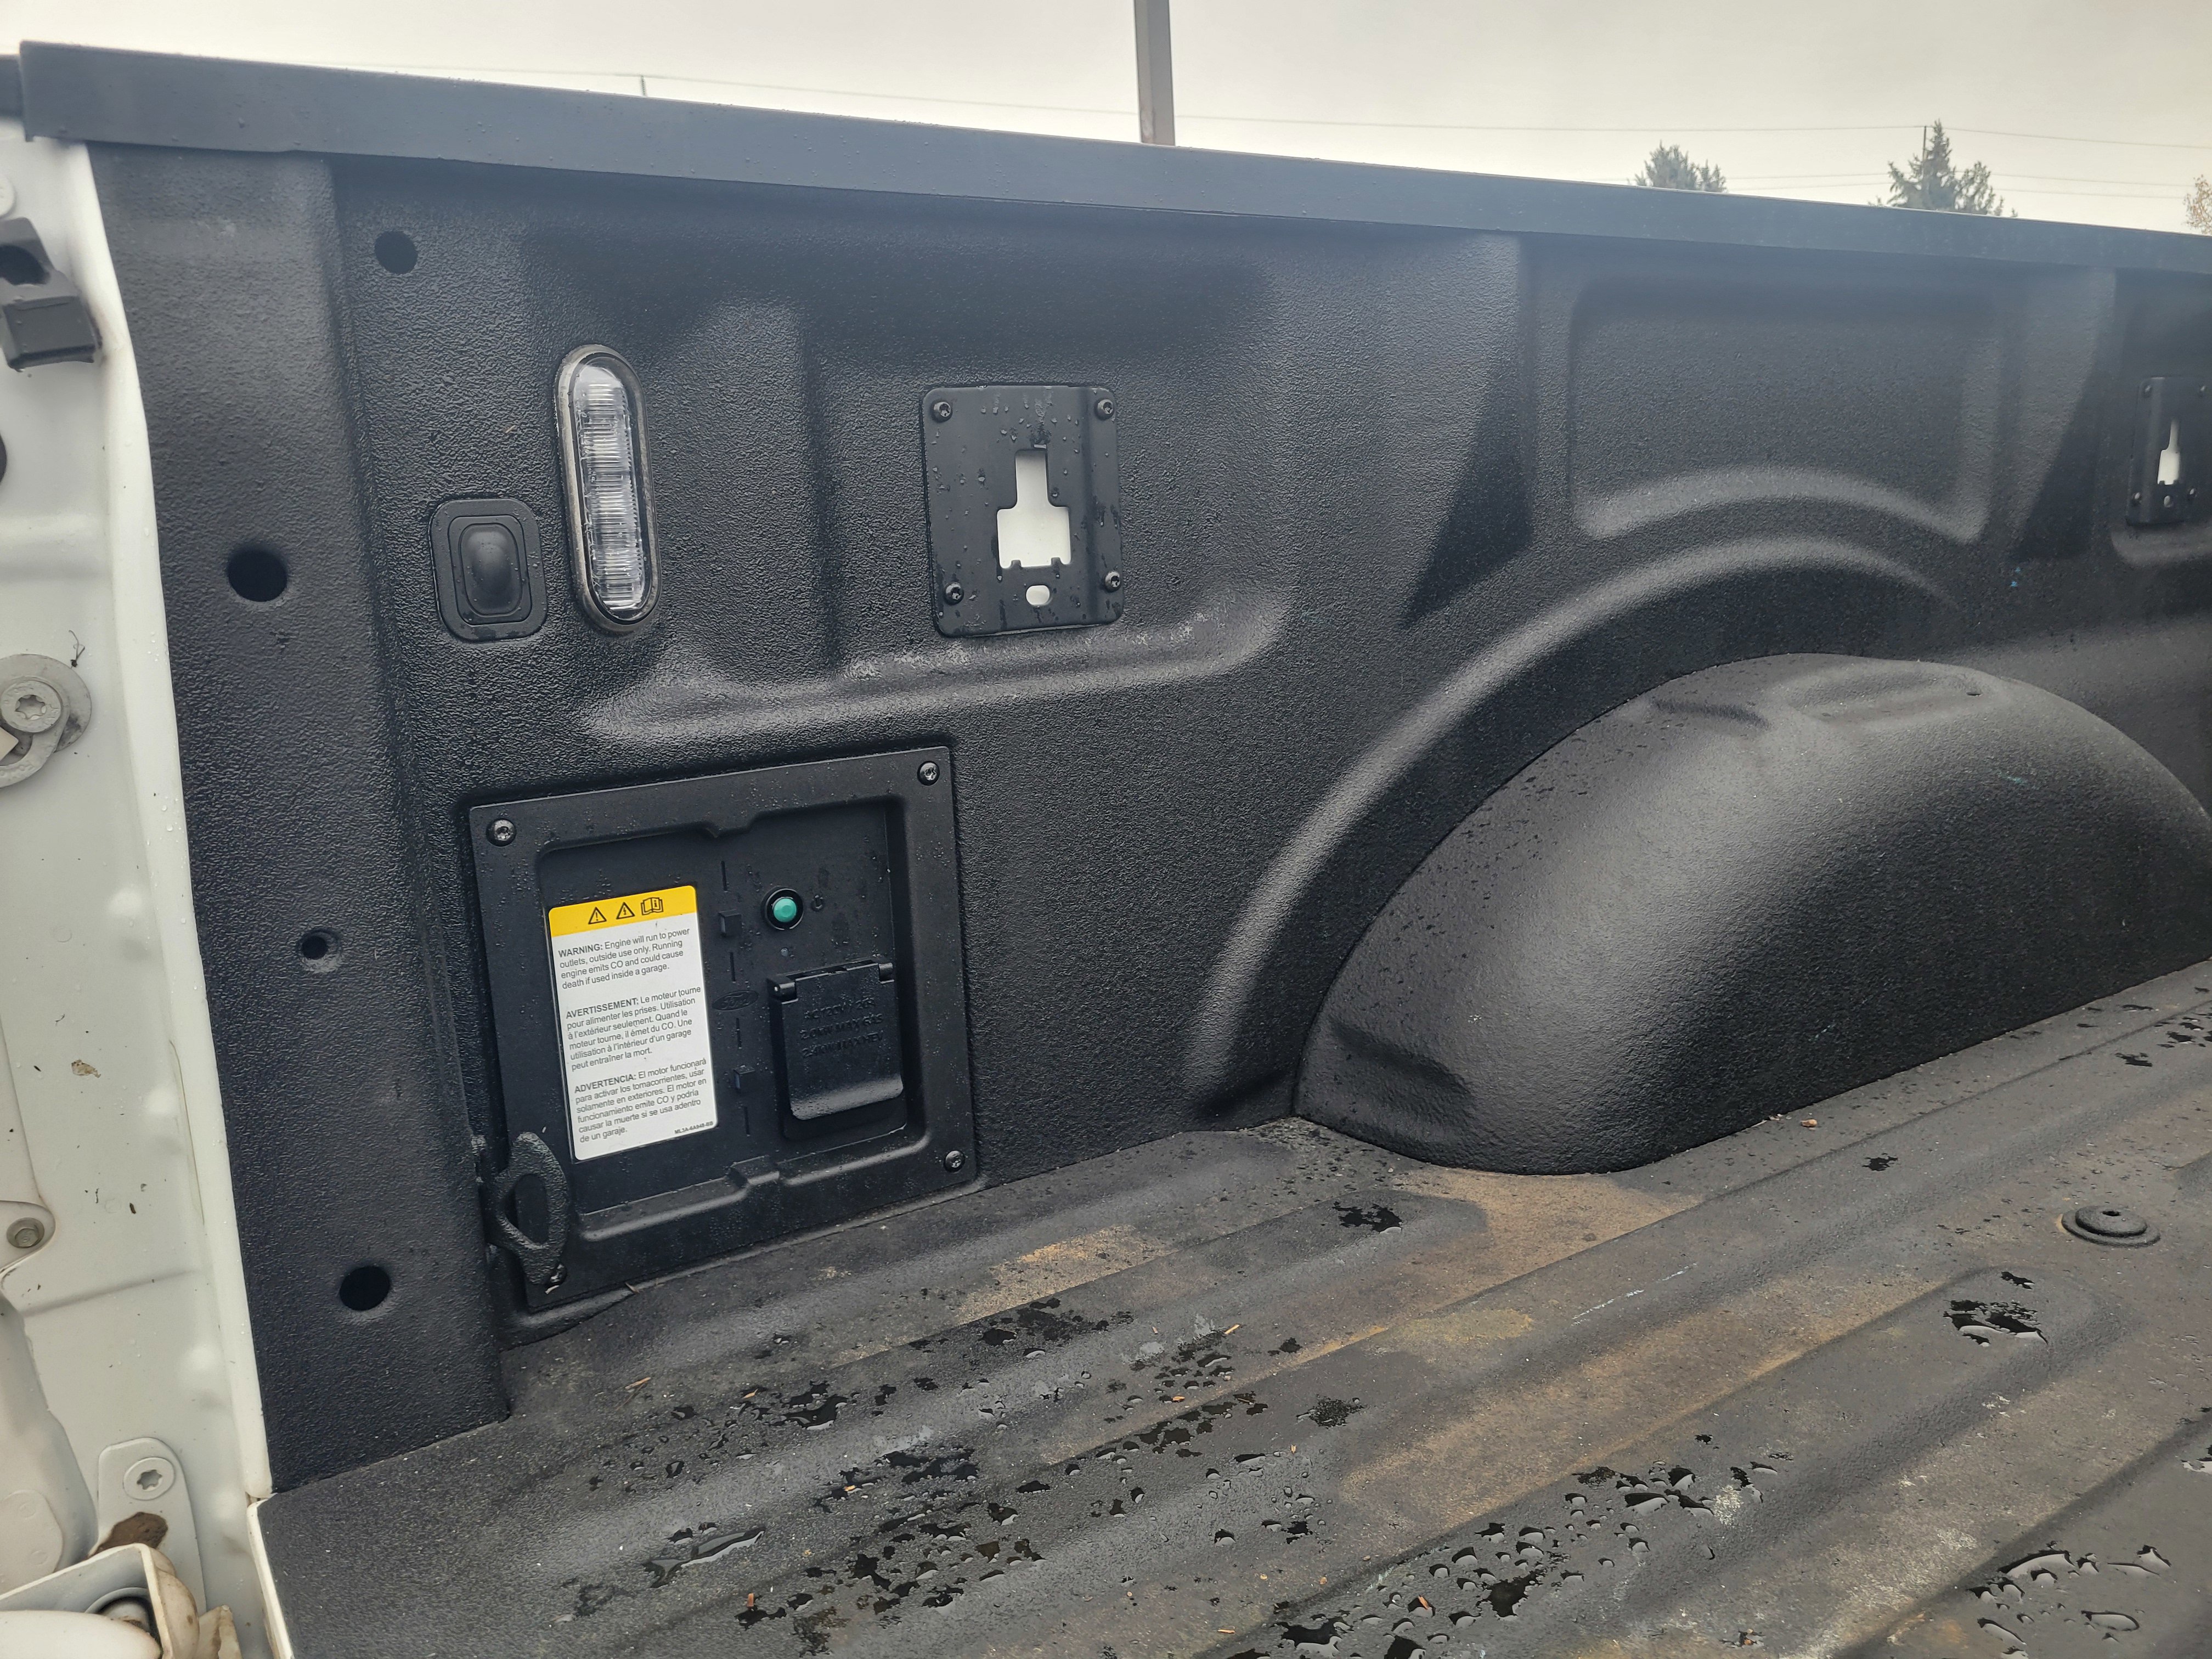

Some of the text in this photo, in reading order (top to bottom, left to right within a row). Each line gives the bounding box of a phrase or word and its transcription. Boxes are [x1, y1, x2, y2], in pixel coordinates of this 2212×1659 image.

[558, 944, 603, 957] WARNING:
[604, 939, 631, 949] Engine
[632, 935, 644, 944] will
[668, 928, 690, 939] power
[560, 957, 588, 968] outlets,
[589, 951, 617, 963] outside
[633, 945, 651, 955] only.
[652, 940, 682, 951] Running
[561, 950, 683, 979] engine emits CO and could cause
[562, 979, 584, 989] death
[585, 977, 590, 985] if
[591, 973, 610, 984] used
[611, 969, 634, 979] inside
[641, 964, 669, 975] garage.
[566, 997, 639, 1019] AVERTISSEMENT:
[651, 991, 677, 1001] moteur
[678, 986, 701, 997] tourne
[567, 1020, 584, 1030] pour
[585, 1013, 620, 1025] alimenter
[634, 1006, 659, 1017] prises.
[660, 998, 695, 1010] Utilisation
[569, 1039, 596, 1050] moteur
[597, 1034, 623, 1043] tourne,
[630, 1026, 650, 1037] émet
[661, 1022, 676, 1030] CO.
[677, 1019, 692, 1027] Une
[574, 1025, 612, 1038] l'extérieur
[612, 1016, 653, 1030] seulement.
[655, 1009, 680, 1021] Quand
[570, 1047, 606, 1060] utilisation
[613, 1038, 648, 1051] l'intérieur
[649, 1035, 665, 1043] d'un
[666, 1029, 691, 1041] garage
[572, 1060, 589, 1071] peut
[589, 1053, 624, 1066] entraîner
[633, 1047, 652, 1057] mort.
[574, 1057, 707, 1093] ADVERTENCIA: El motor funcionará
[575, 1094, 592, 1105] para
[594, 1088, 618, 1099] activar
[632, 1075, 687, 1090] tomacorrientes,
[689, 1069, 704, 1077] usar
[577, 1099, 614, 1113] solamente
[628, 1088, 665, 1101] exteriores.
[667, 1084, 674, 1092] El
[676, 1081, 696, 1090] motor
[578, 1105, 633, 1123] funcionamiento
[635, 1100, 654, 1109] emite
[656, 1096, 669, 1104] CO
[676, 1089, 699, 1102] podría
[579, 1122, 603, 1133] causar
[614, 1114, 639, 1124] muerte
[641, 1110, 647, 1118] si
[674, 1099, 701, 1110] adentro
[602, 1126, 627, 1139] garaje.
